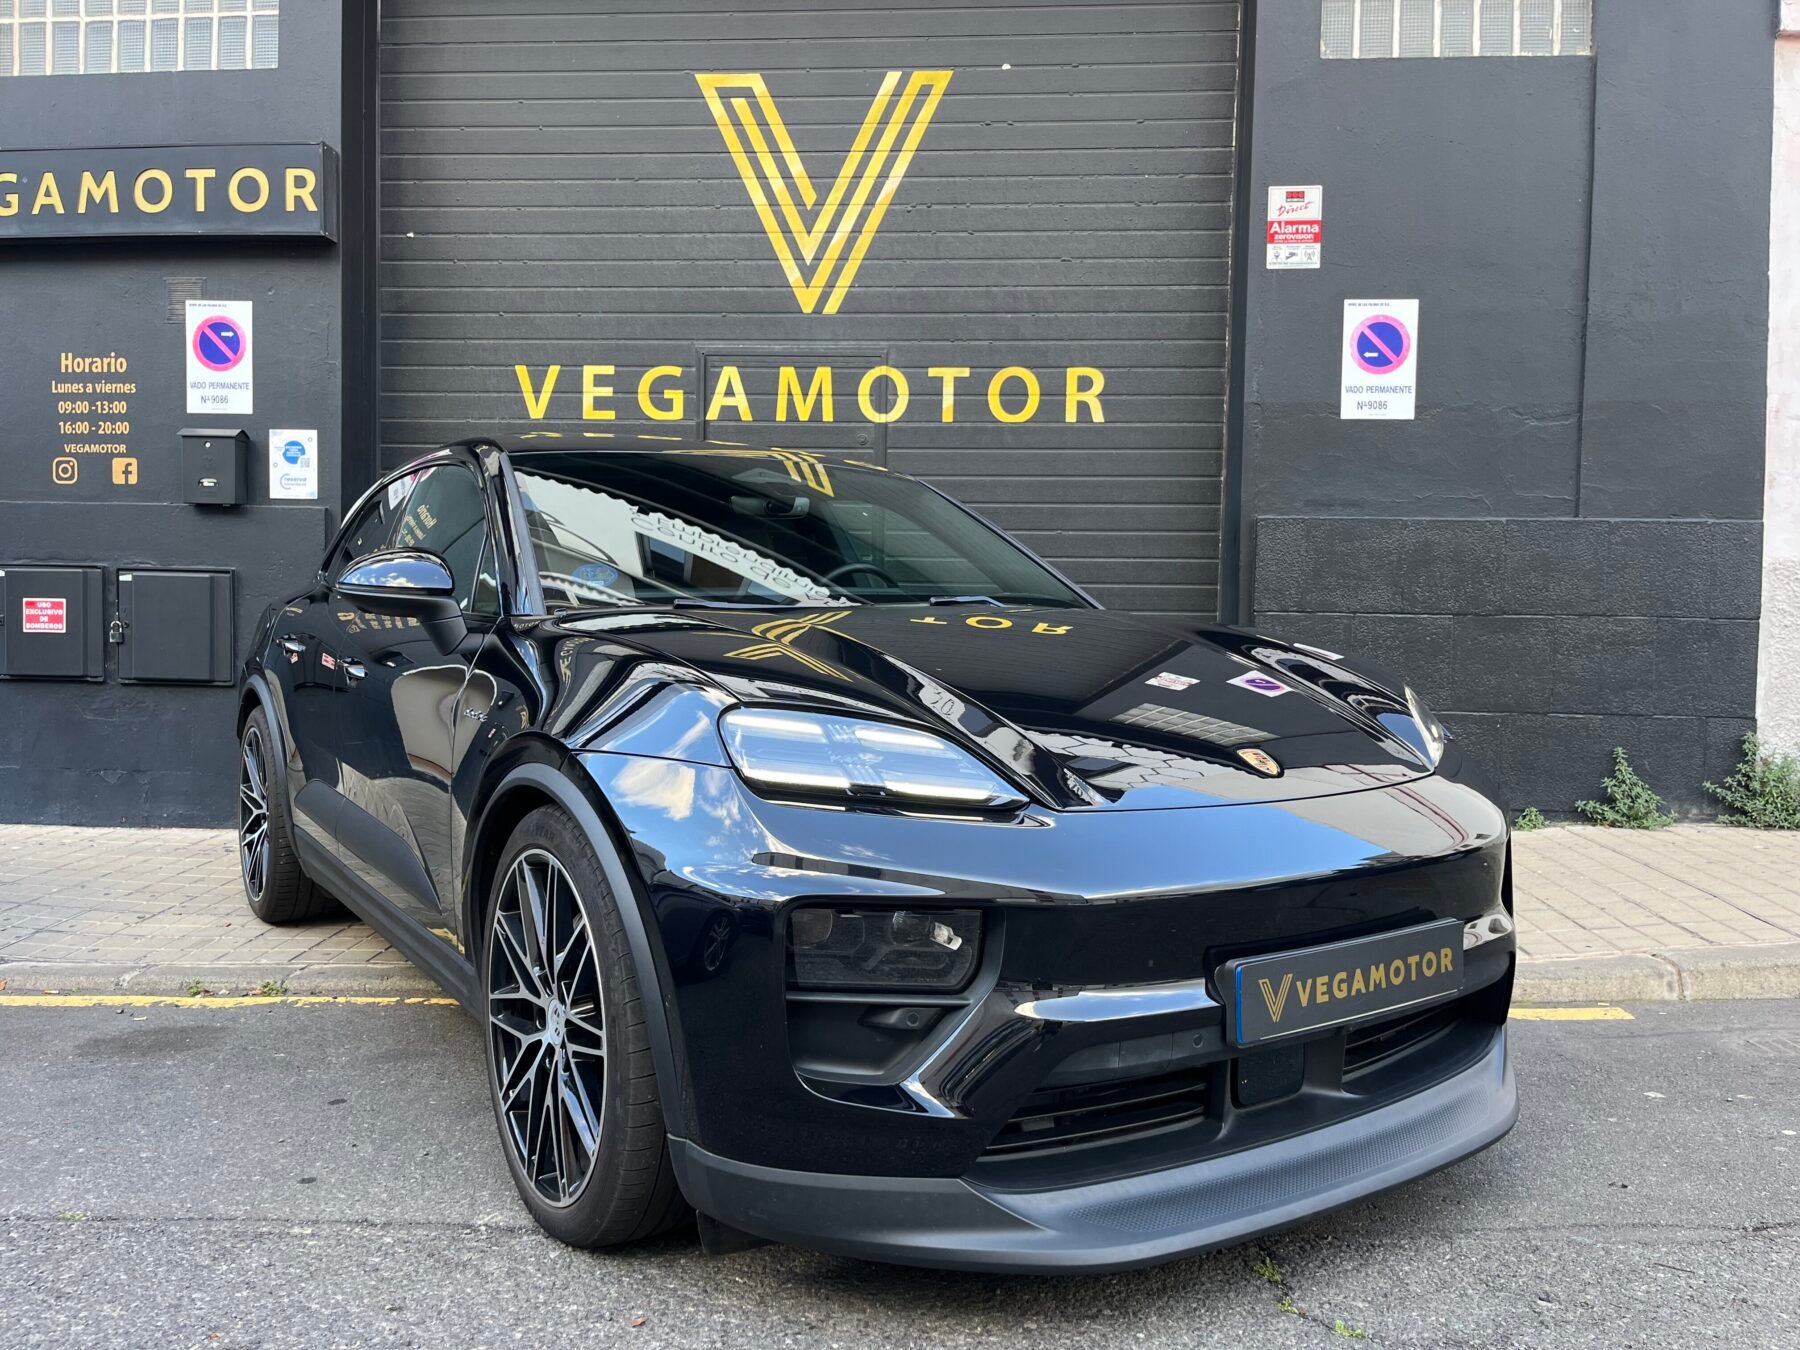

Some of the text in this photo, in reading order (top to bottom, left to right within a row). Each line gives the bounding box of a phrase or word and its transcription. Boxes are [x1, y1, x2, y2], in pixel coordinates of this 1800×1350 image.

[1269, 221, 1320, 234] Alarma
[60, 352, 127, 373] Horario
[51, 380, 136, 393] Lunes a viernes
[190, 381, 250, 390] VADO PERMANENTE
[1345, 385, 1413, 394] VADO PERMANENTE
[514, 364, 1105, 424] VEGAMOTOR
[58, 401, 89, 414] 09:00
[58, 421, 89, 434] 16:00
[98, 421, 130, 434] 20:00
[64, 443, 127, 453] VEGAMOTOR
[1296, 947, 1454, 1008] VEGAMOTOR
